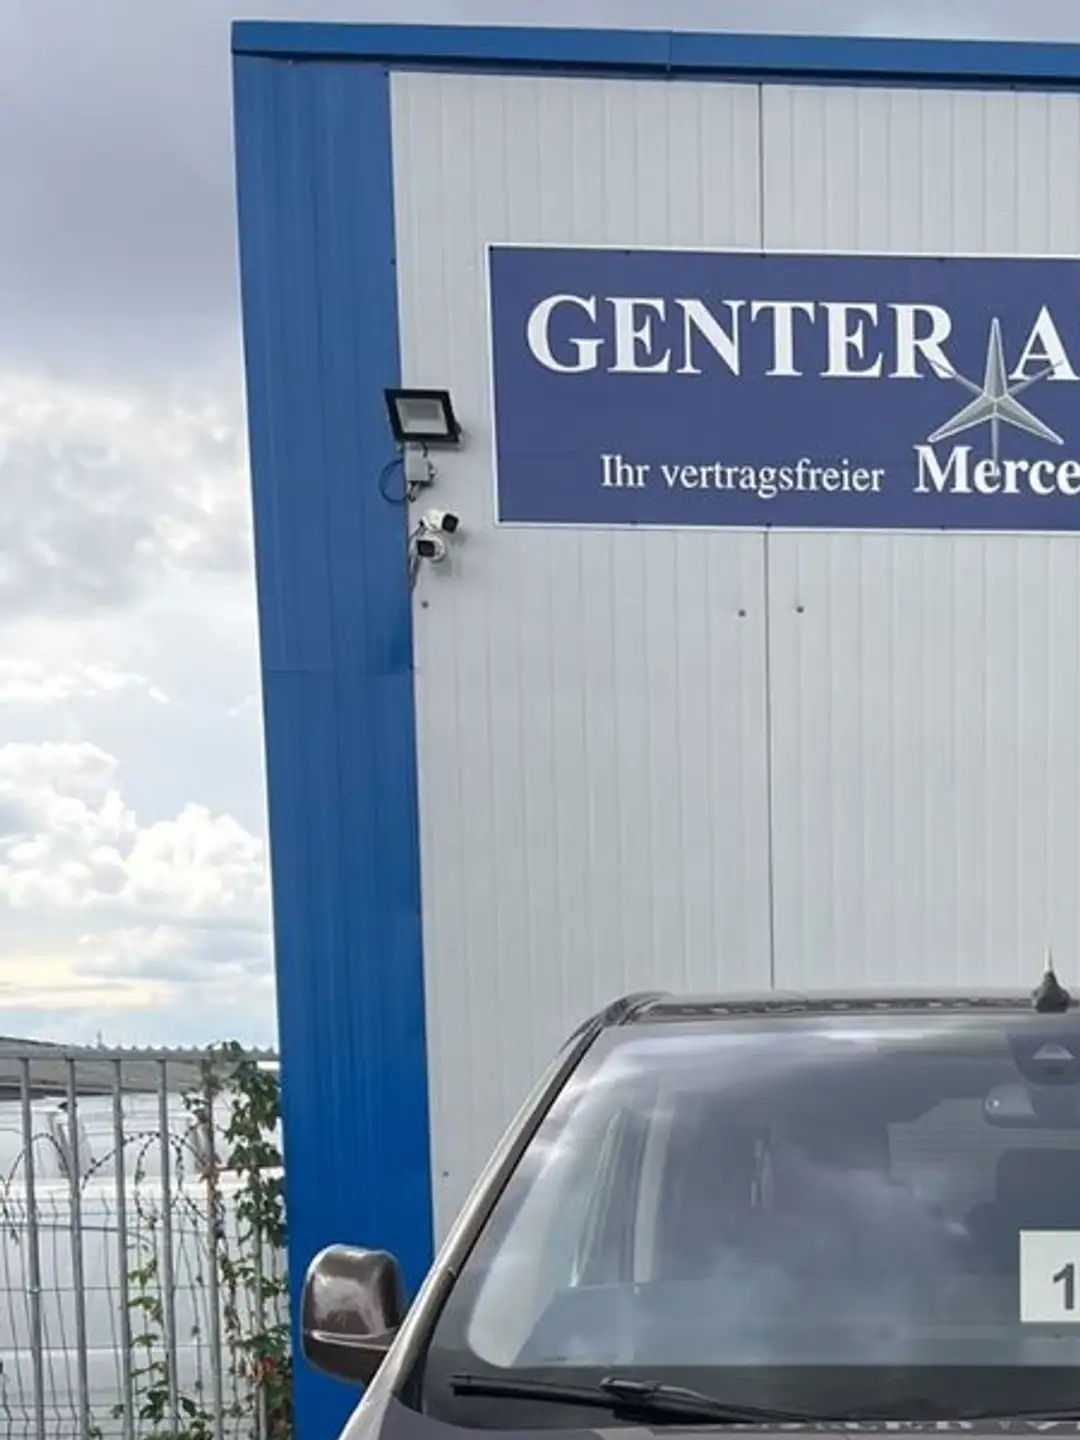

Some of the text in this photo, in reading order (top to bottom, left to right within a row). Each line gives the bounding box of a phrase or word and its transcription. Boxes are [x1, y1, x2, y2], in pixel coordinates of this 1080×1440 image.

[526, 294, 956, 379] GENTER
[600, 454, 650, 488] Ihr
[660, 456, 886, 499] vertragsfreier
